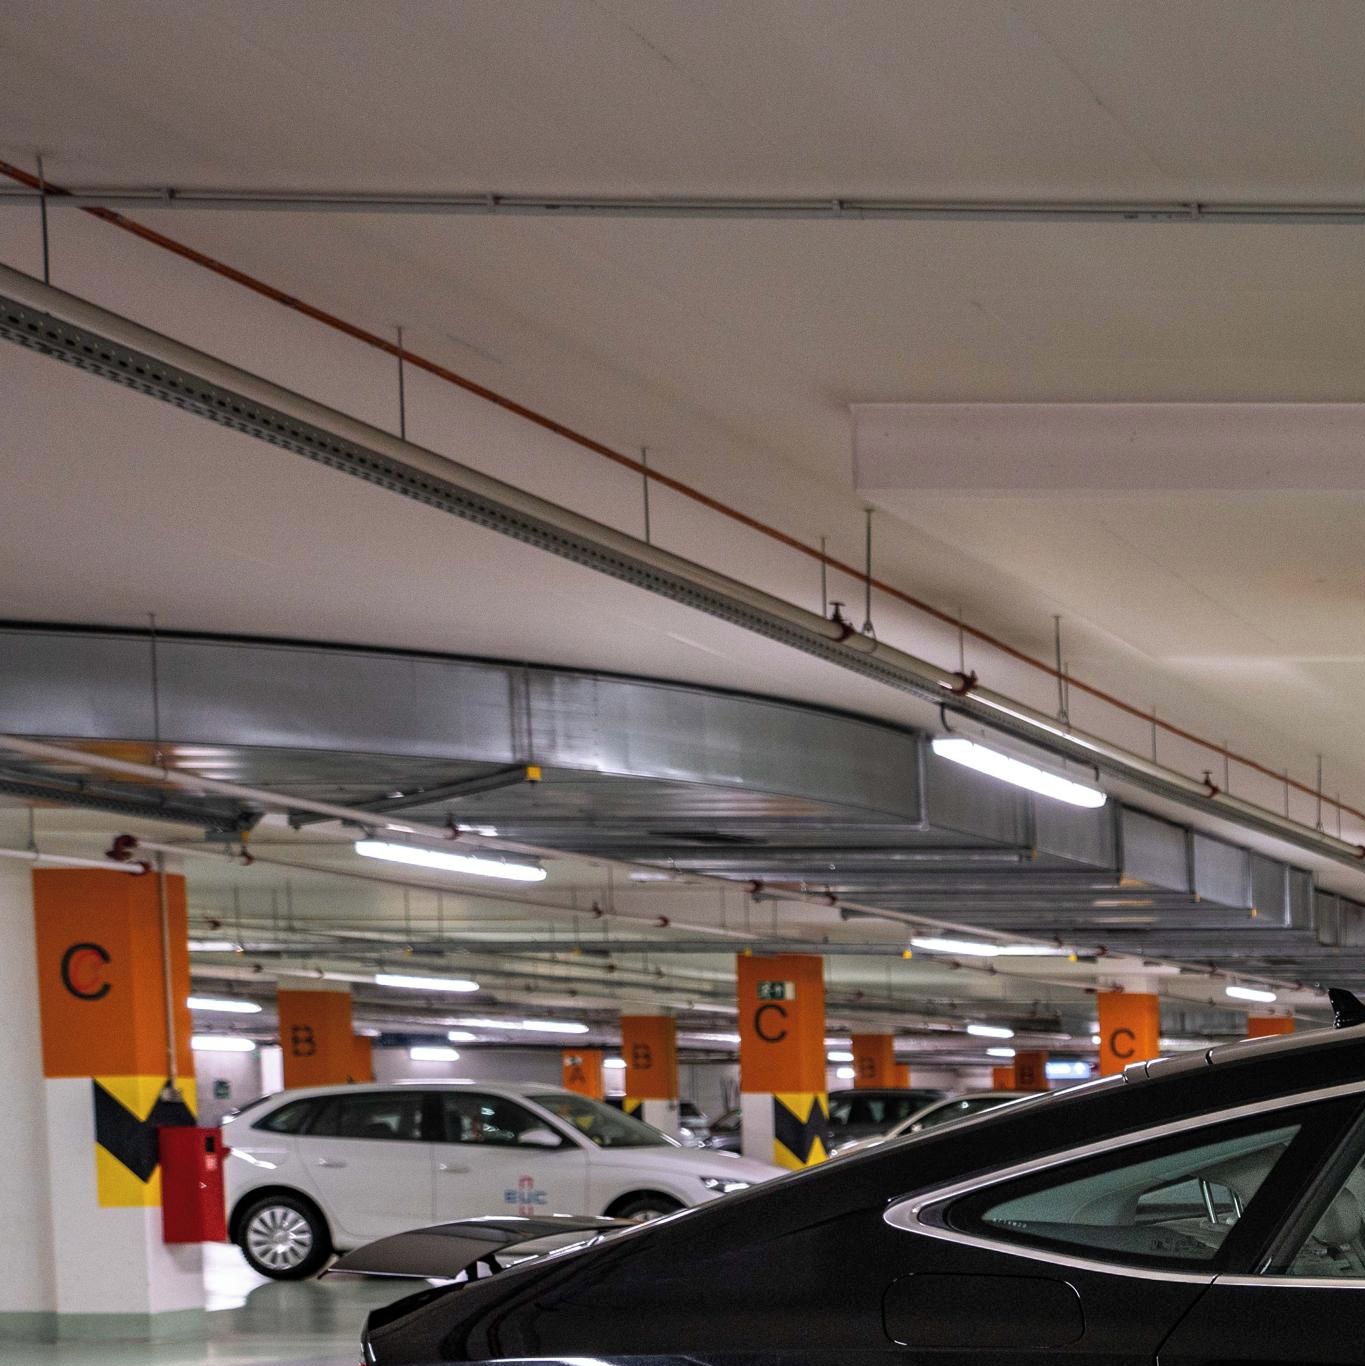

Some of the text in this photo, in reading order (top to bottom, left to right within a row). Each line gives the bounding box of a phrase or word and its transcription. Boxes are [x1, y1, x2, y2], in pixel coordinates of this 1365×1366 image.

[60, 943, 111, 1002] C
[755, 1004, 787, 1043] C
[291, 1025, 317, 1057] B
[633, 1043, 653, 1070] B
[1110, 1028, 1137, 1058] C
